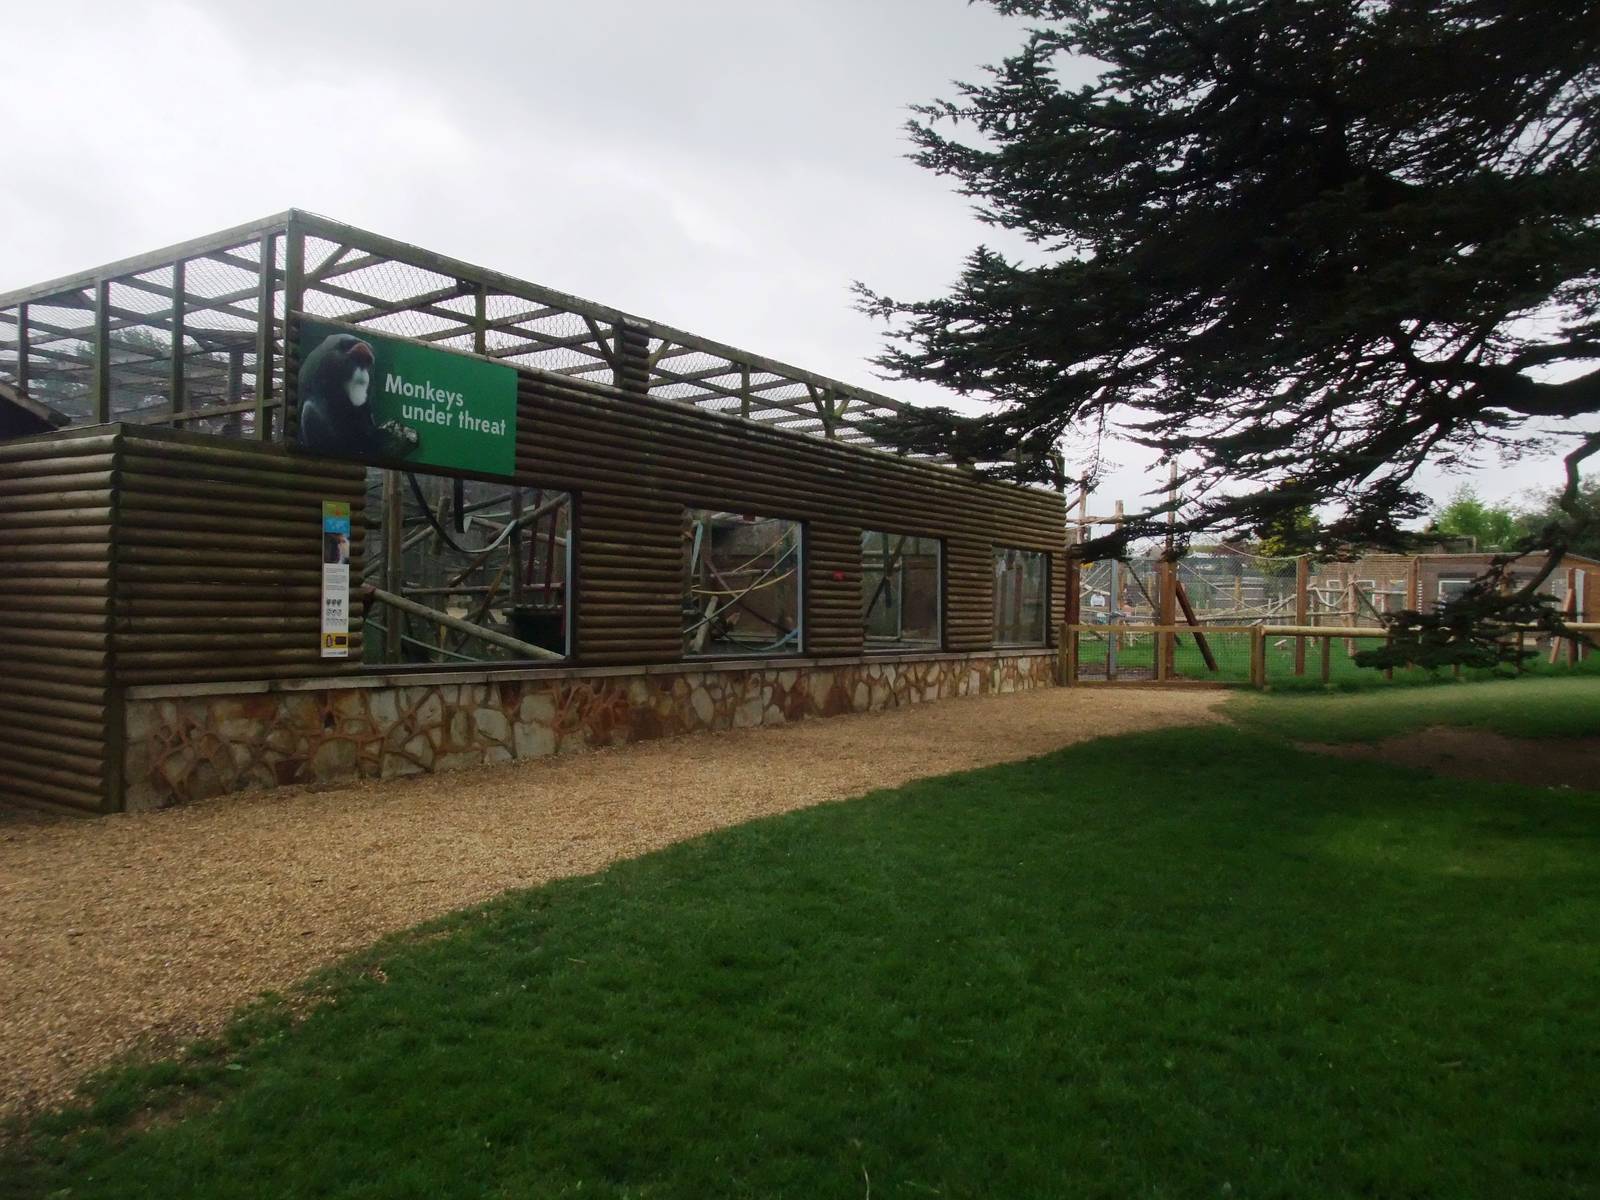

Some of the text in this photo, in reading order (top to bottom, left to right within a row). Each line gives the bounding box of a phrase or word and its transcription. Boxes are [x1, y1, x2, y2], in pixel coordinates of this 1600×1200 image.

[385, 373, 464, 410] Monkeys
[402, 404, 506, 436] under threat
